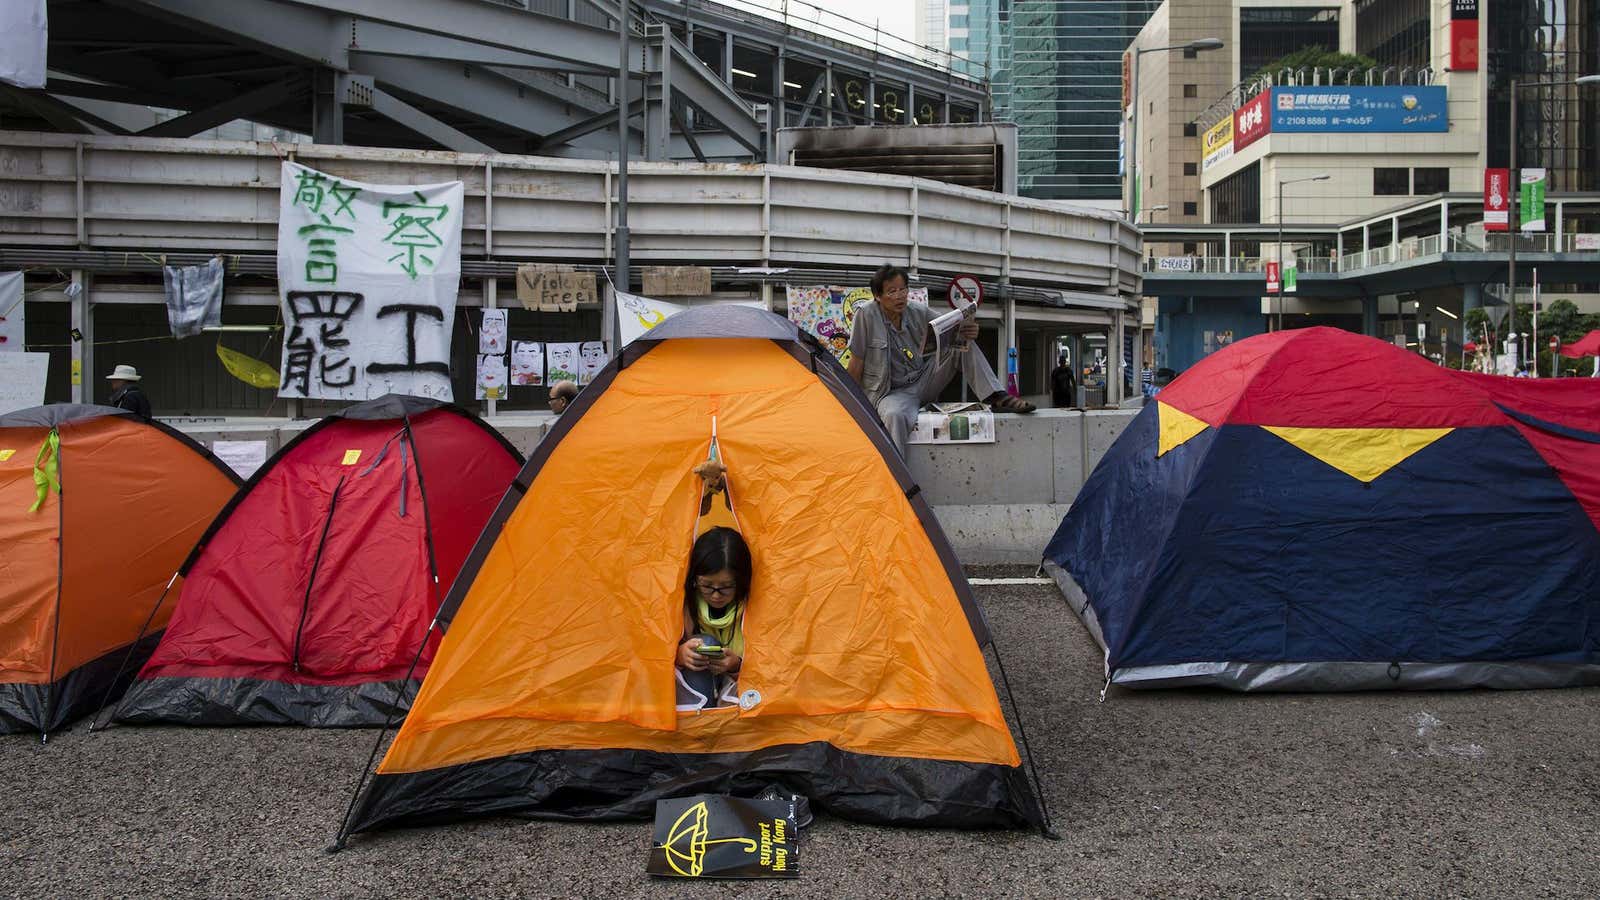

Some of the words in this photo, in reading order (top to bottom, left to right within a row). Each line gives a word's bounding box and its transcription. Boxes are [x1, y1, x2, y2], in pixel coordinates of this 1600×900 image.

[292, 168, 449, 286] 警察
[281, 291, 450, 398] 罷工
[759, 822, 772, 866] support
[773, 818, 787, 846] Kong
[772, 848, 787, 871] Hong
